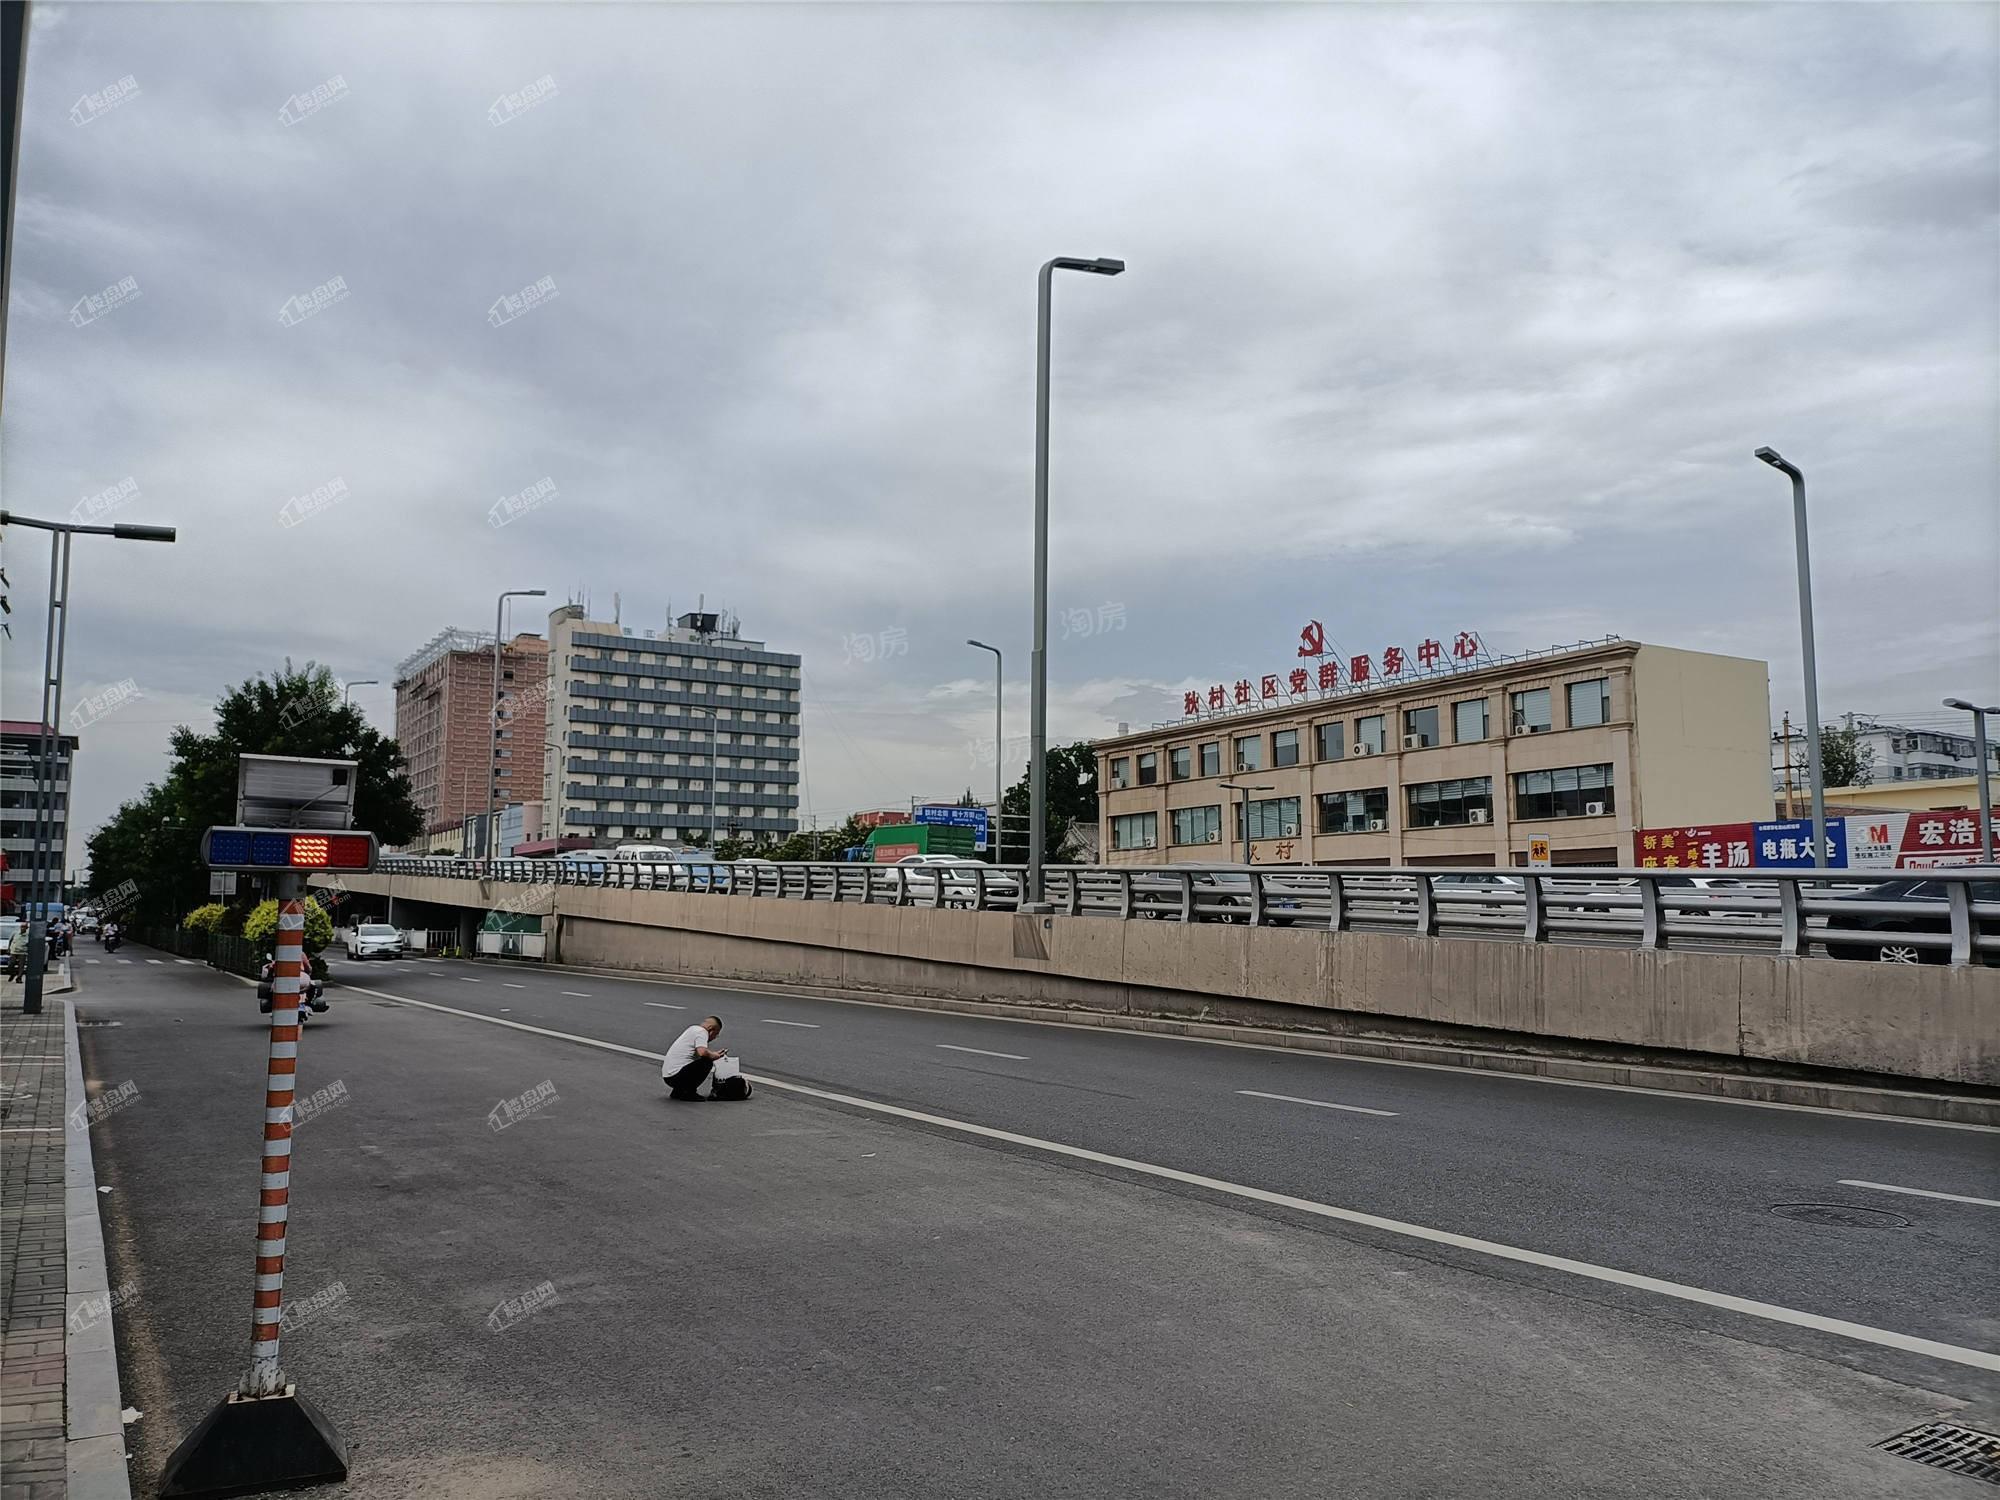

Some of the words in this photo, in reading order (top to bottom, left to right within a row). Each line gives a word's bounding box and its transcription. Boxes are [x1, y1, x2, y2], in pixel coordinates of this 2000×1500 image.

[1184, 631, 1478, 715] 狄村社区党群服务中心
[1856, 824, 1889, 844] 3M
[1702, 841, 1750, 868] 羊汤
[1762, 836, 1837, 860] 电瓶大全
